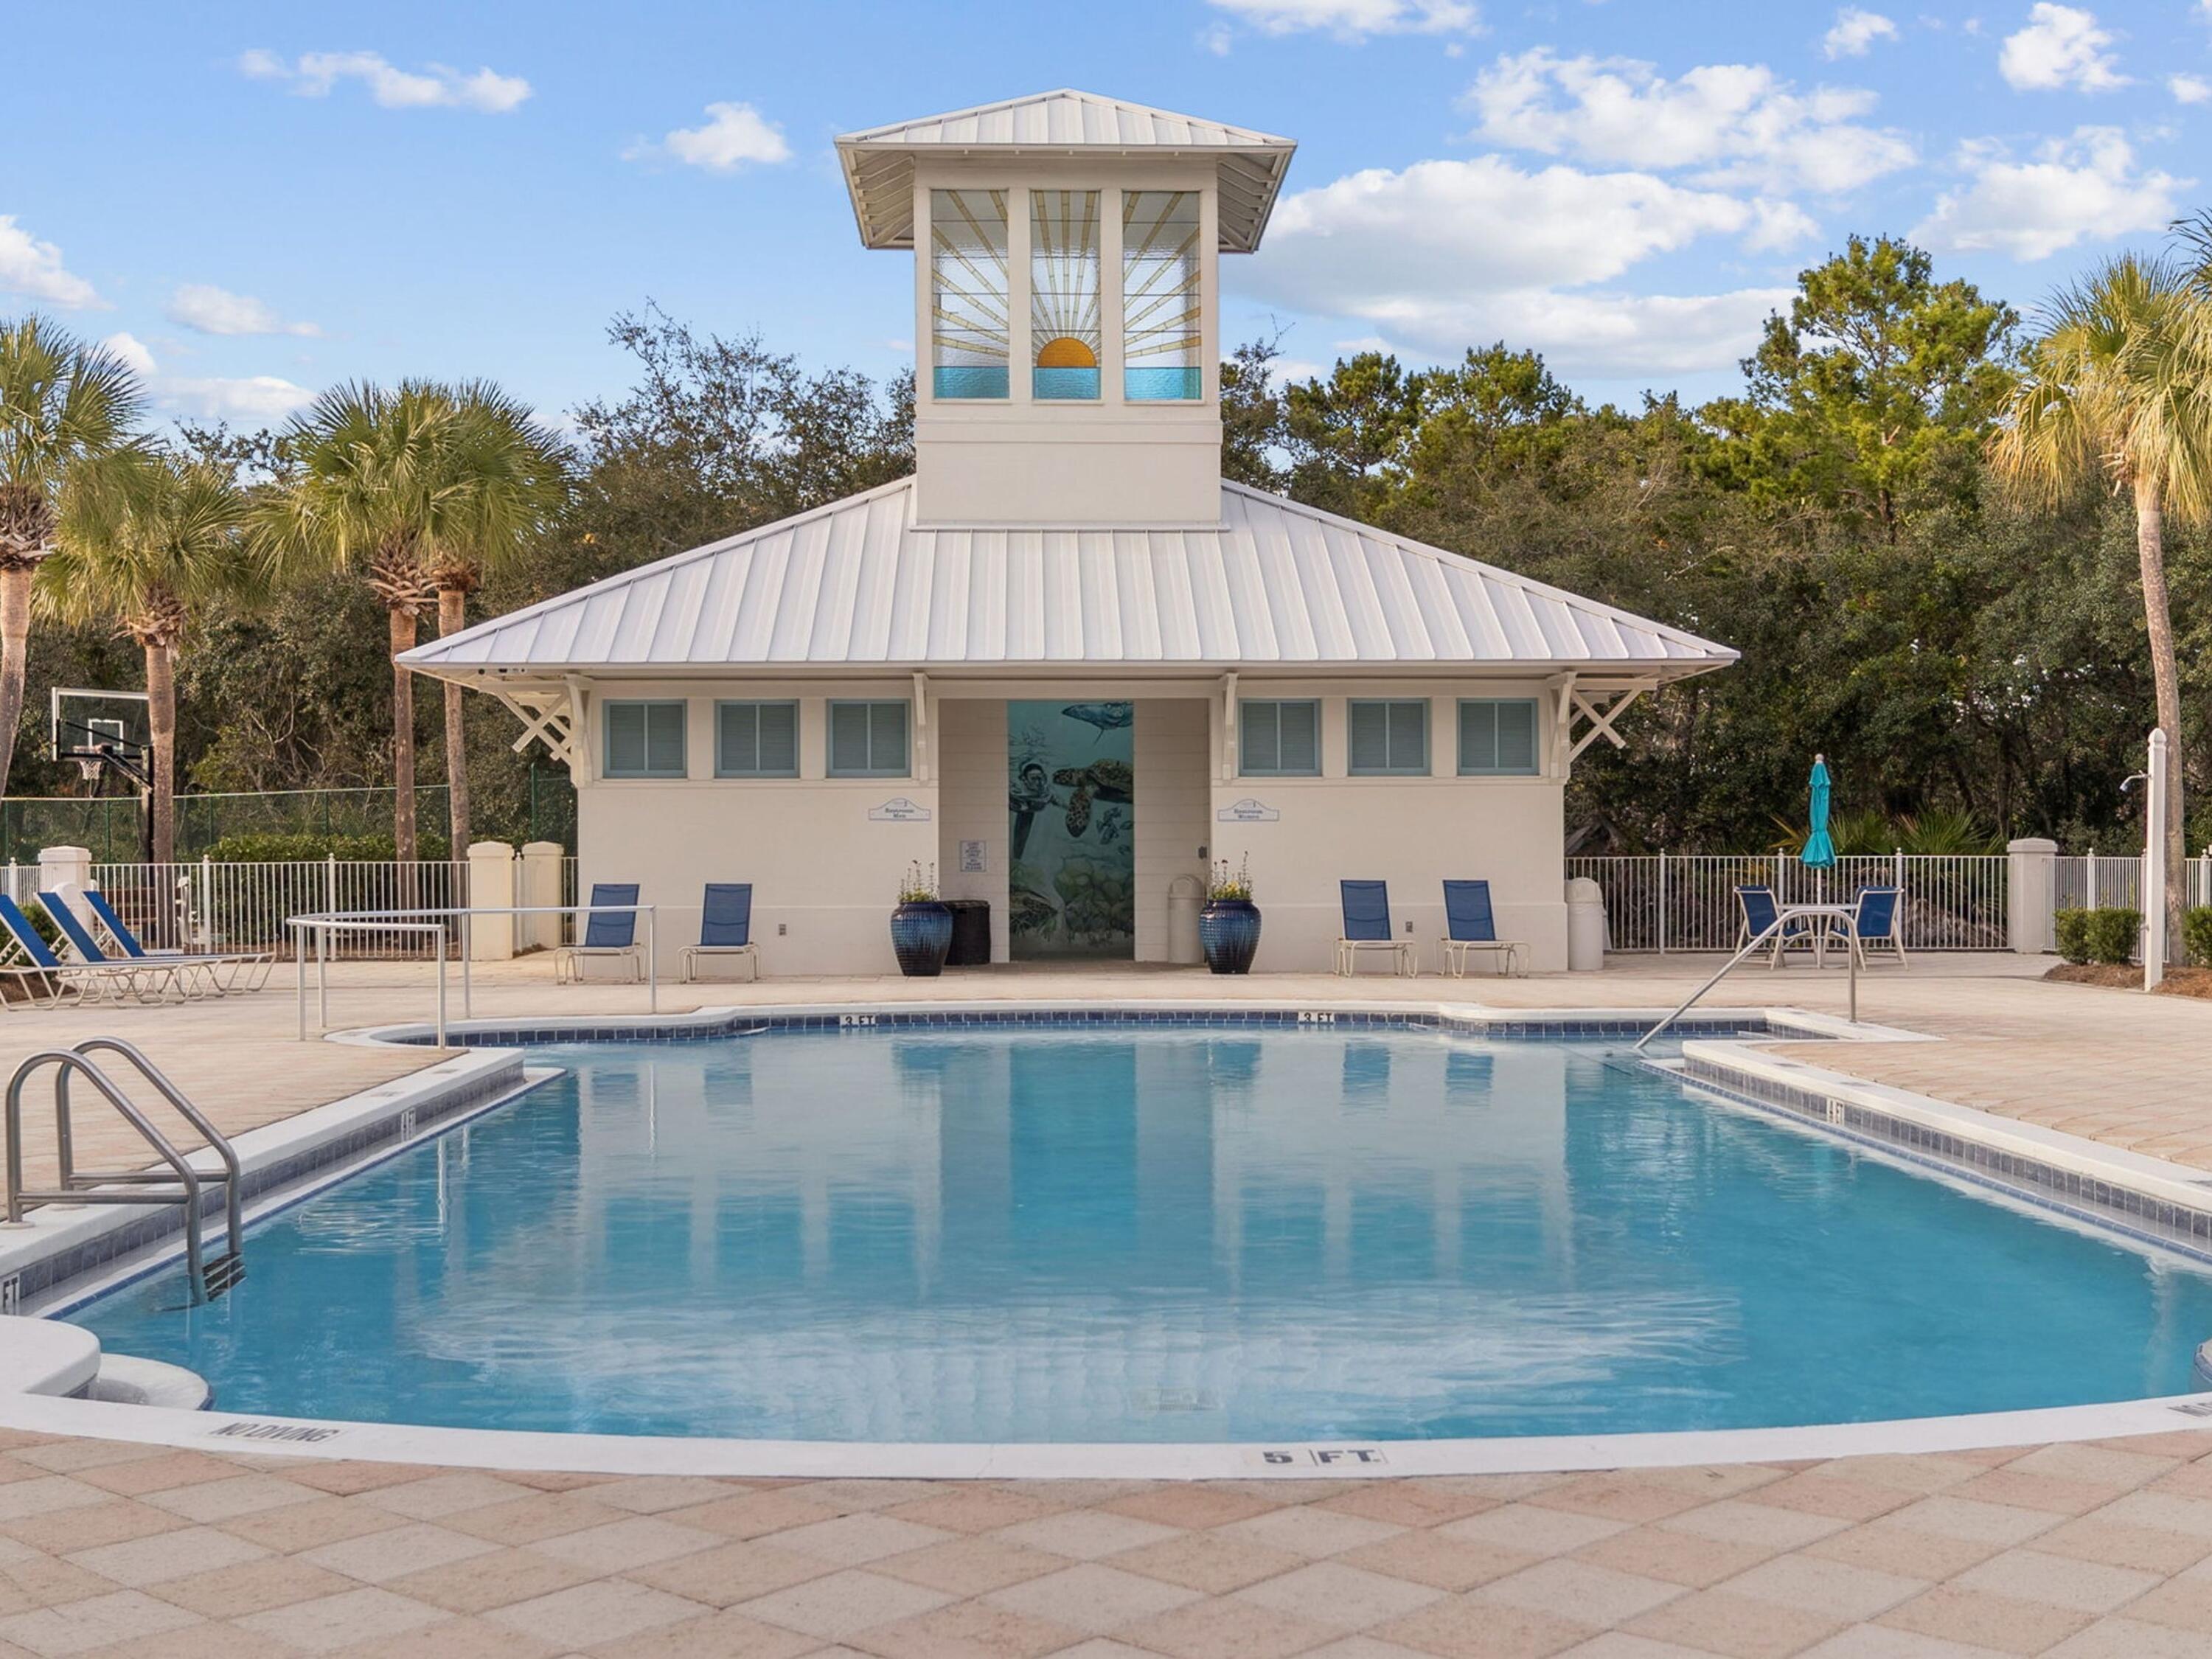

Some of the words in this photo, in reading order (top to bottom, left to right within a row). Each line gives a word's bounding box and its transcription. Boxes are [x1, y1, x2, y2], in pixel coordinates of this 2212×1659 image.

[859, 1015, 873, 1025] FT
[1318, 1012, 1332, 1023] FT
[3, 1276, 18, 1308] FT
[209, 1422, 260, 1436] NO
[1263, 1451, 1293, 1464] 5
